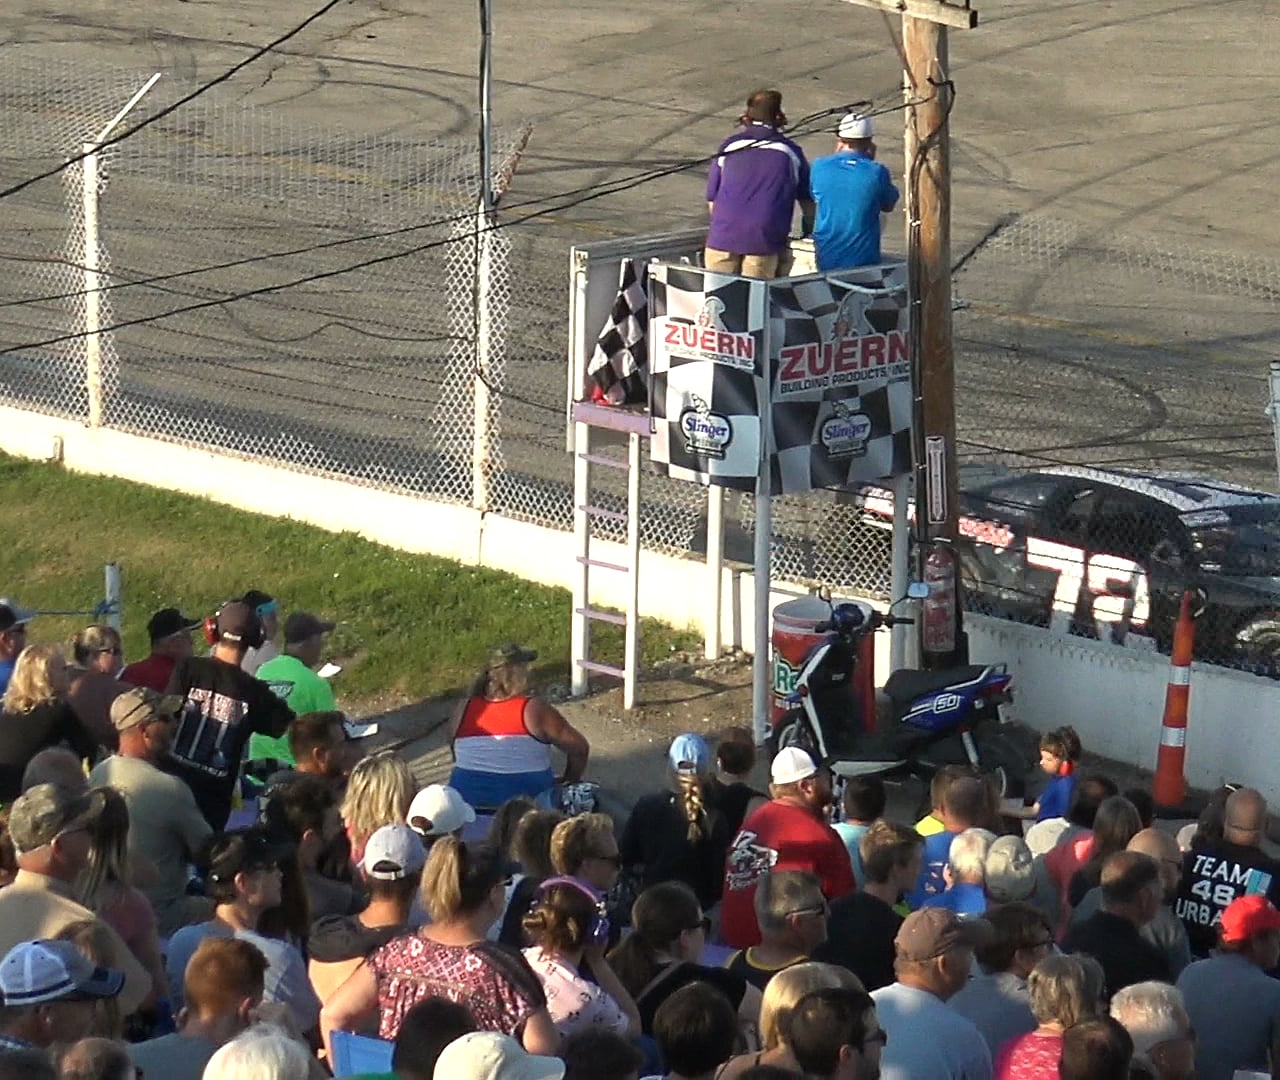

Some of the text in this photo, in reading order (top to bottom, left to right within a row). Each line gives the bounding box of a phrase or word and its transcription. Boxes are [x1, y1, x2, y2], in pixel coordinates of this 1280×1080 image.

[664, 323, 754, 360] ZUERN
[780, 331, 910, 381] ZUERN
[781, 376, 830, 394] BUILDING
[685, 417, 728, 439] Slinger
[825, 423, 869, 440] Slinger
[1192, 854, 1253, 887] TEAM
[1191, 880, 1235, 906] 48
[1175, 898, 1224, 927] URBA
